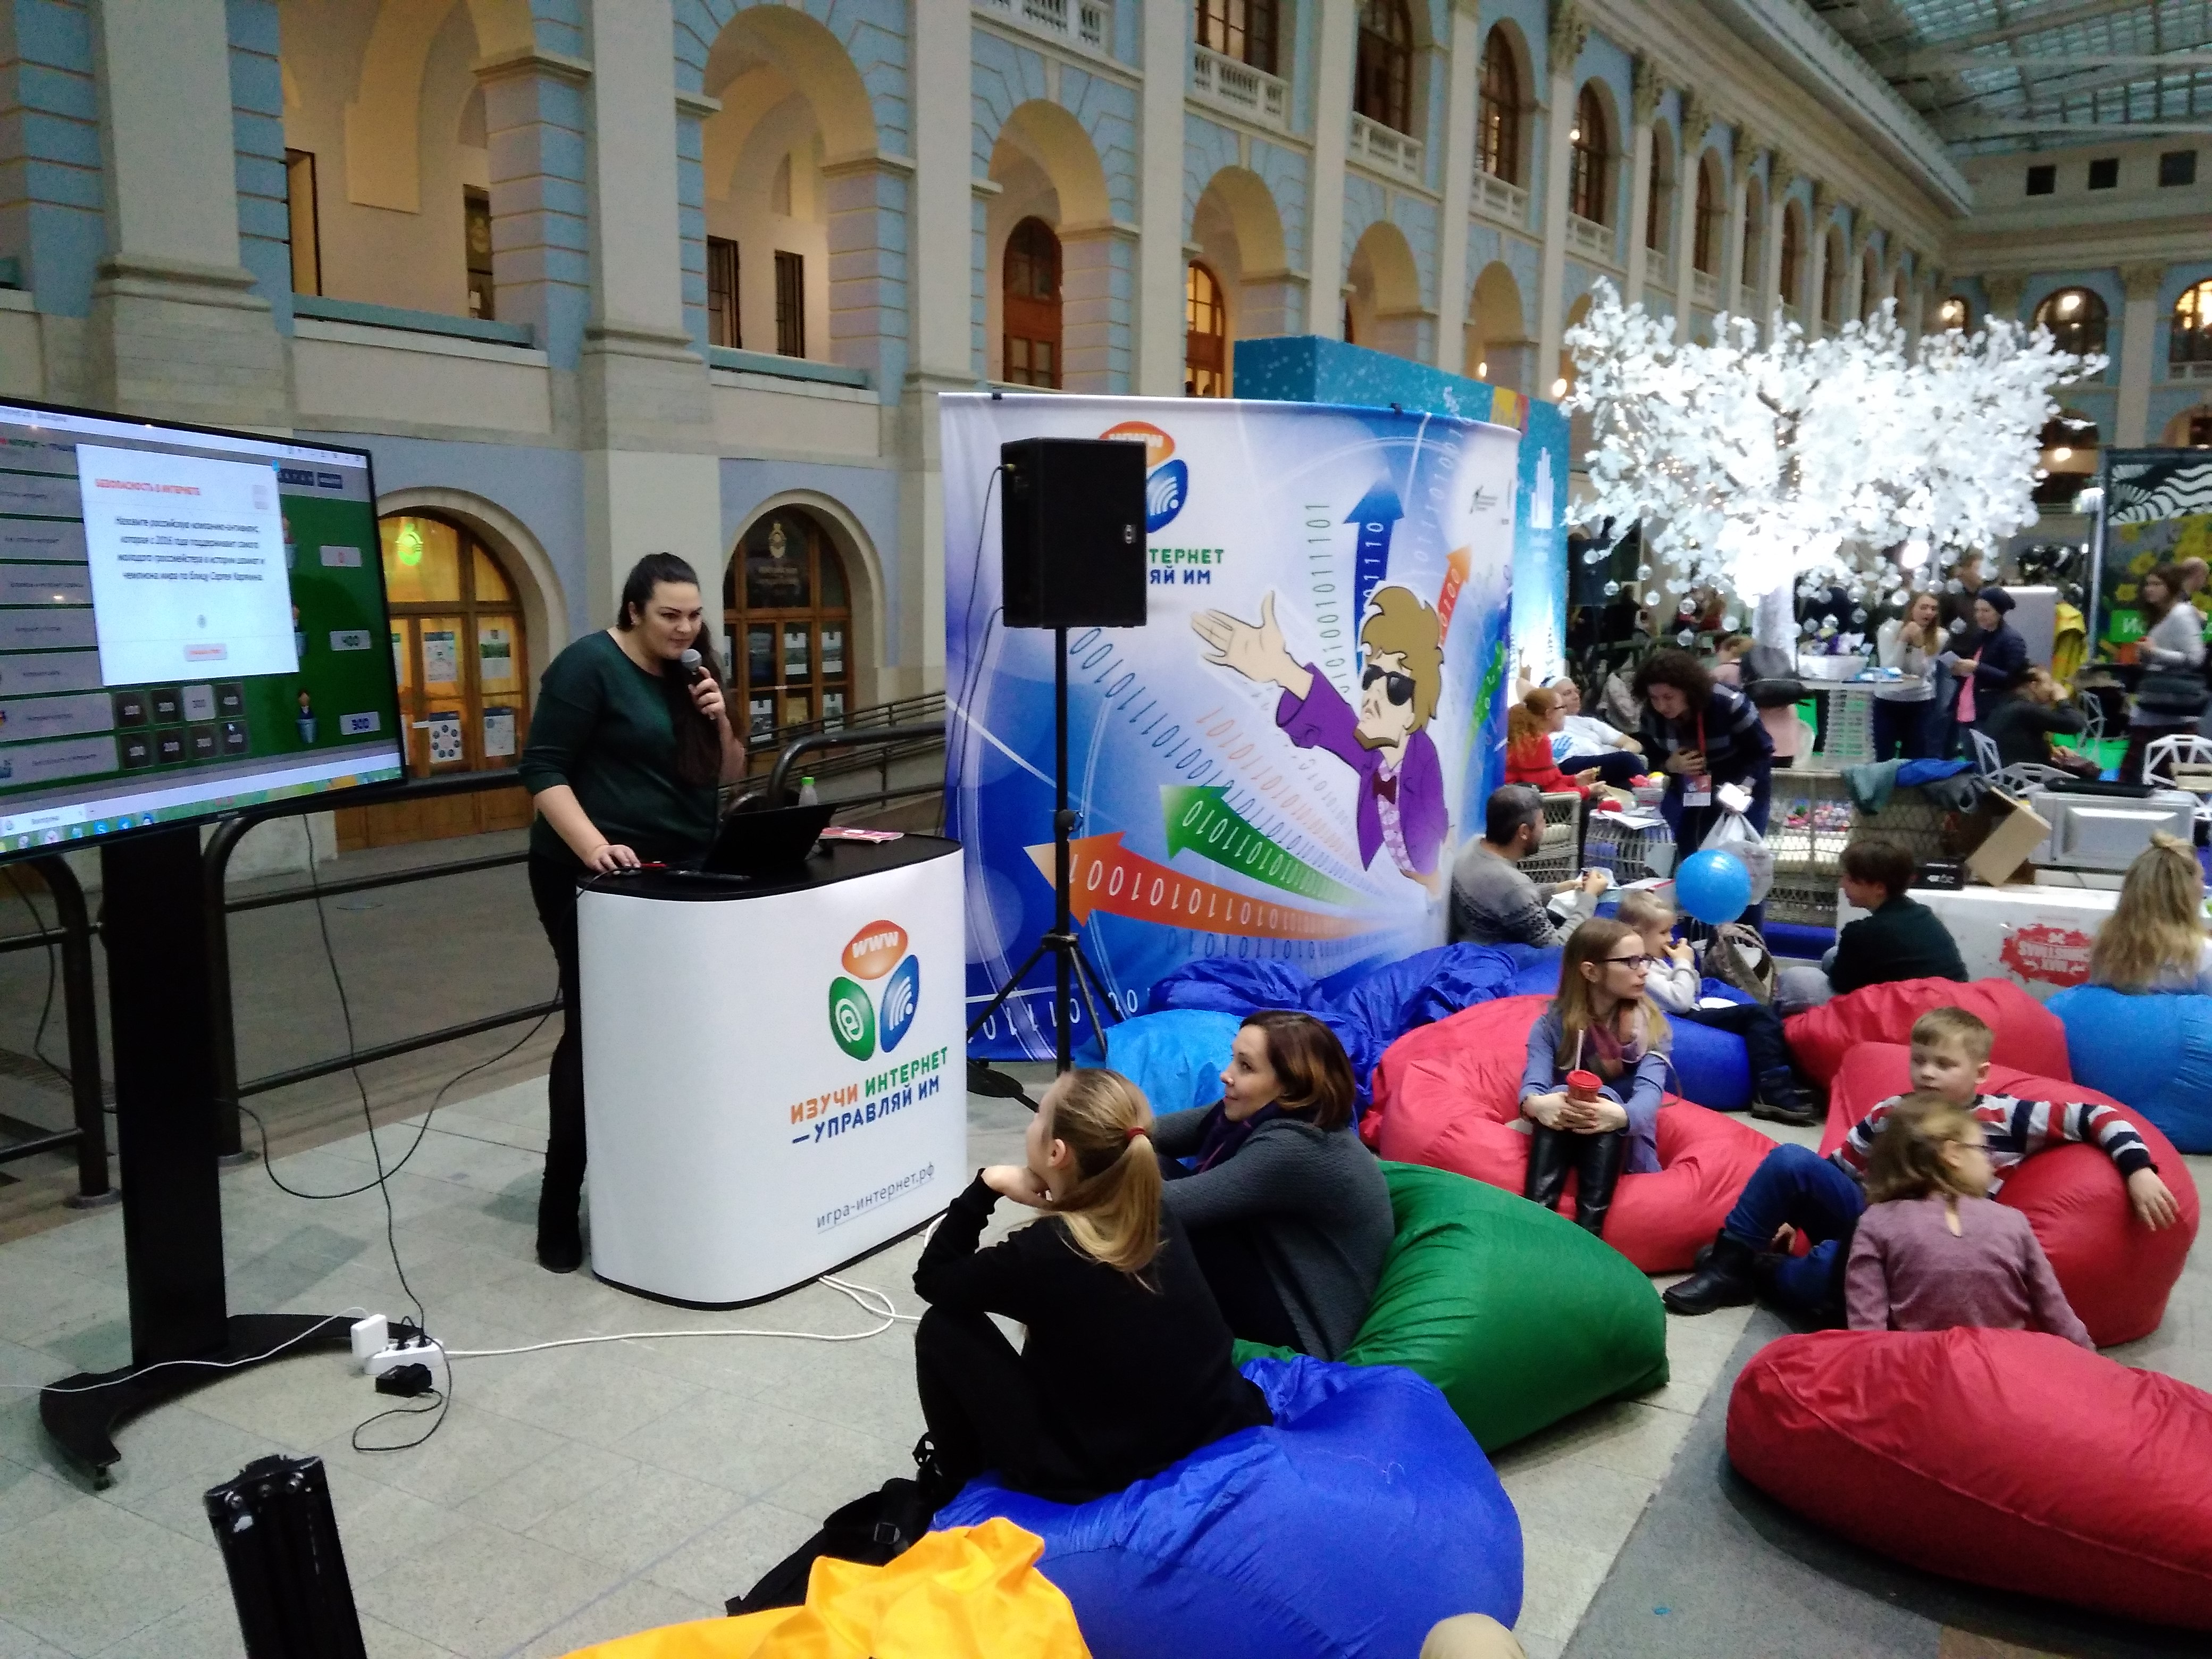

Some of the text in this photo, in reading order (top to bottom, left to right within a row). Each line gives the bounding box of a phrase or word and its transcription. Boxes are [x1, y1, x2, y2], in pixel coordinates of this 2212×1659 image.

[1183, 569, 1211, 584] ИМ
[791, 1046, 948, 1124] ИЗУЧИ ИНТЕРНЕТ
[918, 1075, 939, 1101] ИМ
[817, 1161, 935, 1228] игра-интернет.рф
